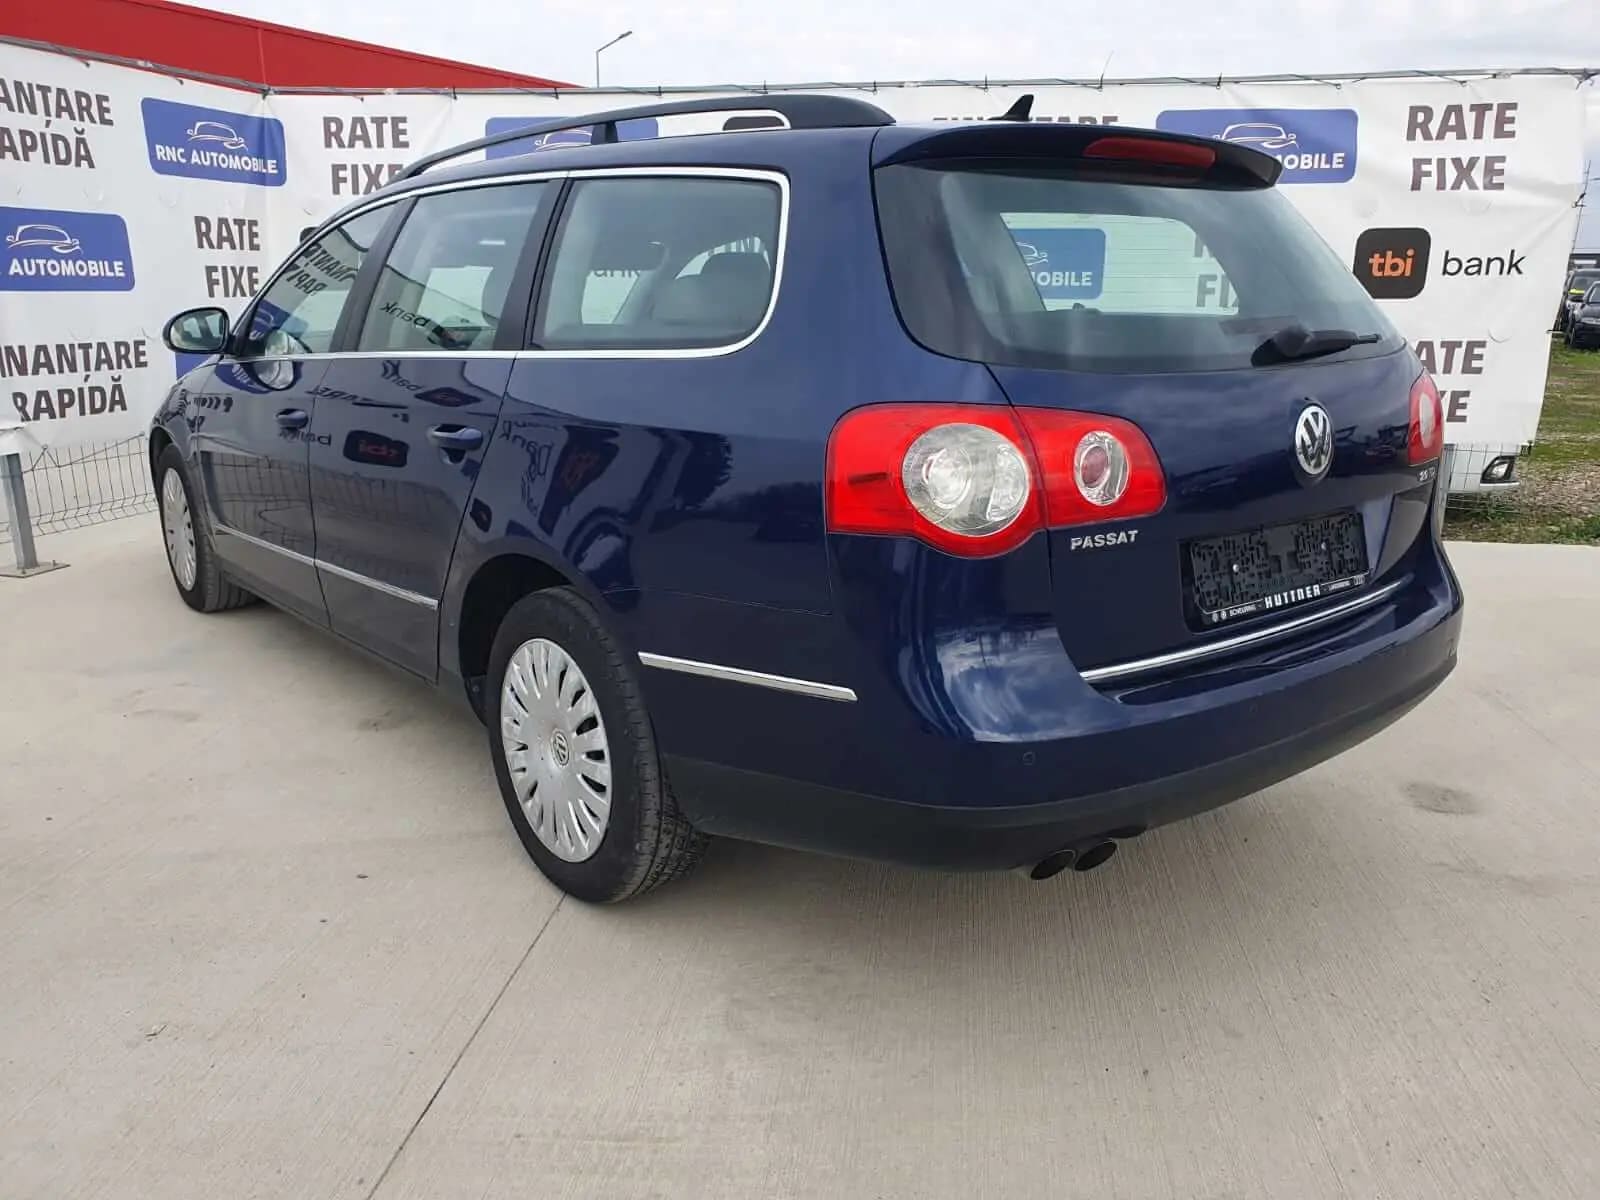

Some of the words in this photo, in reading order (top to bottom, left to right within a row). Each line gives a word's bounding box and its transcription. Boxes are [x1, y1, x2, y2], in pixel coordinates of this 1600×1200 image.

[323, 116, 410, 149] RATE
[1406, 102, 1518, 141] RATE
[155, 144, 187, 164] RNC
[191, 151, 279, 174] AUTOMOBILE
[1276, 153, 1345, 169] OBILE
[1410, 155, 1507, 191] FIXE
[194, 216, 261, 251] RATE
[8, 258, 126, 277] AUTOMOBILE
[1368, 248, 1416, 278] tbi
[1442, 249, 1527, 276] bank
[205, 266, 260, 298] FIXE
[1031, 271, 1093, 287] OBILE
[1415, 340, 1487, 375] ATE
[1070, 530, 1140, 551] PASSAT
